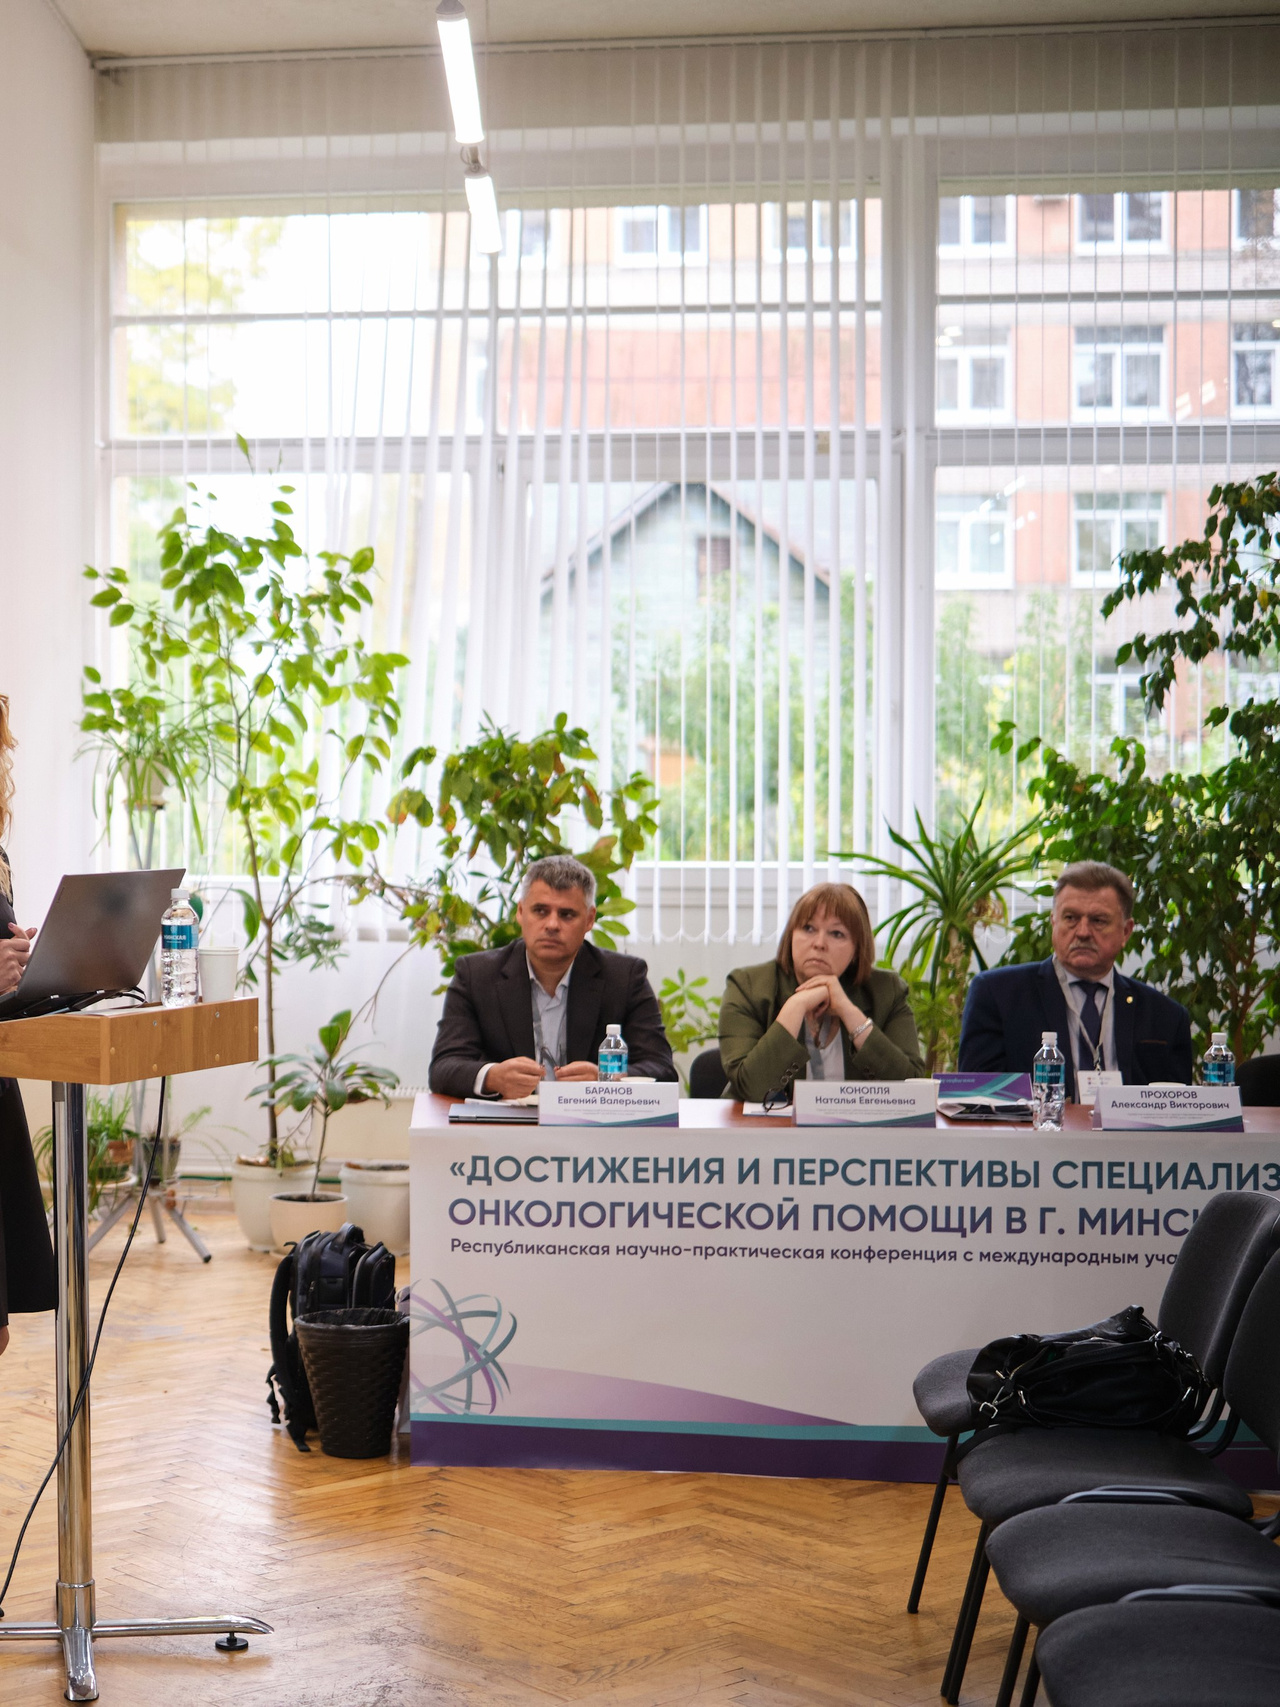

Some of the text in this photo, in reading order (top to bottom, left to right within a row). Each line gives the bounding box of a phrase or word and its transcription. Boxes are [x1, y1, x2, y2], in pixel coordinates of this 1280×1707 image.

[585, 1087, 632, 1095] БАРАНОВ
[840, 1086, 890, 1095] КОНОПЛЯ
[1141, 1090, 1197, 1099] ПРОХОРОВ
[558, 1096, 660, 1106] Евгений Валерьевич
[815, 1096, 915, 1106] Наталья Евгеньевна
[1111, 1101, 1229, 1110] Александр Викторович
[450, 1155, 1280, 1195] «ДОСТИЖЕНИЯ И ПЕРСПЕКТИВЫ СПЕЦИАЛИЗ
[449, 1197, 1199, 1238] ОНКОЛОГИЧЕСКОЙ ПОМОЩИ В Г. МИНС
[450, 1238, 610, 1257] Республиканская
[616, 1244, 824, 1260] научно-практическая
[830, 1245, 957, 1263] конференция
[963, 1249, 974, 1262] с
[979, 1248, 1139, 1267] международным
